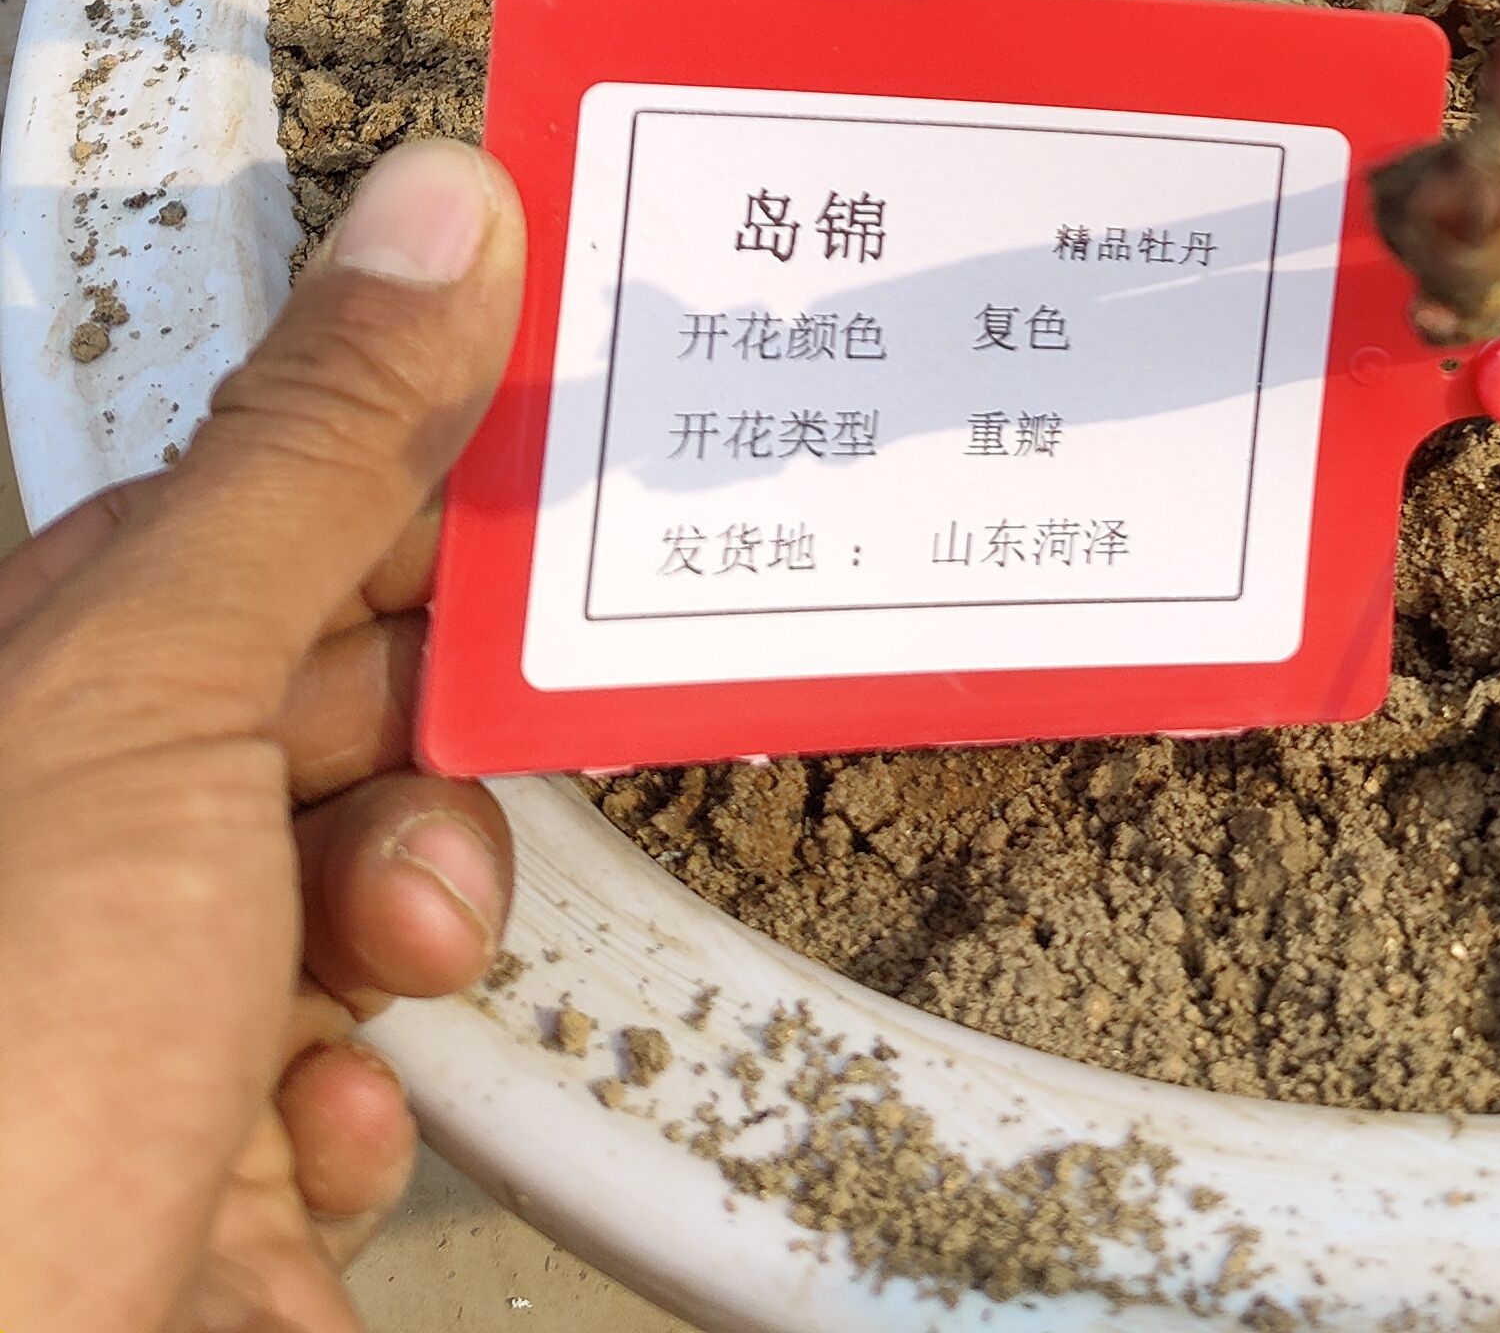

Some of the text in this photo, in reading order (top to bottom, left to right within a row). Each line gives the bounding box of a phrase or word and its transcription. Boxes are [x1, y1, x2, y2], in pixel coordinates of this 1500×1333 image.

[734, 187, 888, 266] 岛锦
[1052, 224, 1220, 268] 精品牡丹
[678, 303, 1072, 362] 开花颜色 复色
[668, 409, 1064, 461] 开花类型 重瓣
[931, 518, 1131, 569] 山东菏泽
